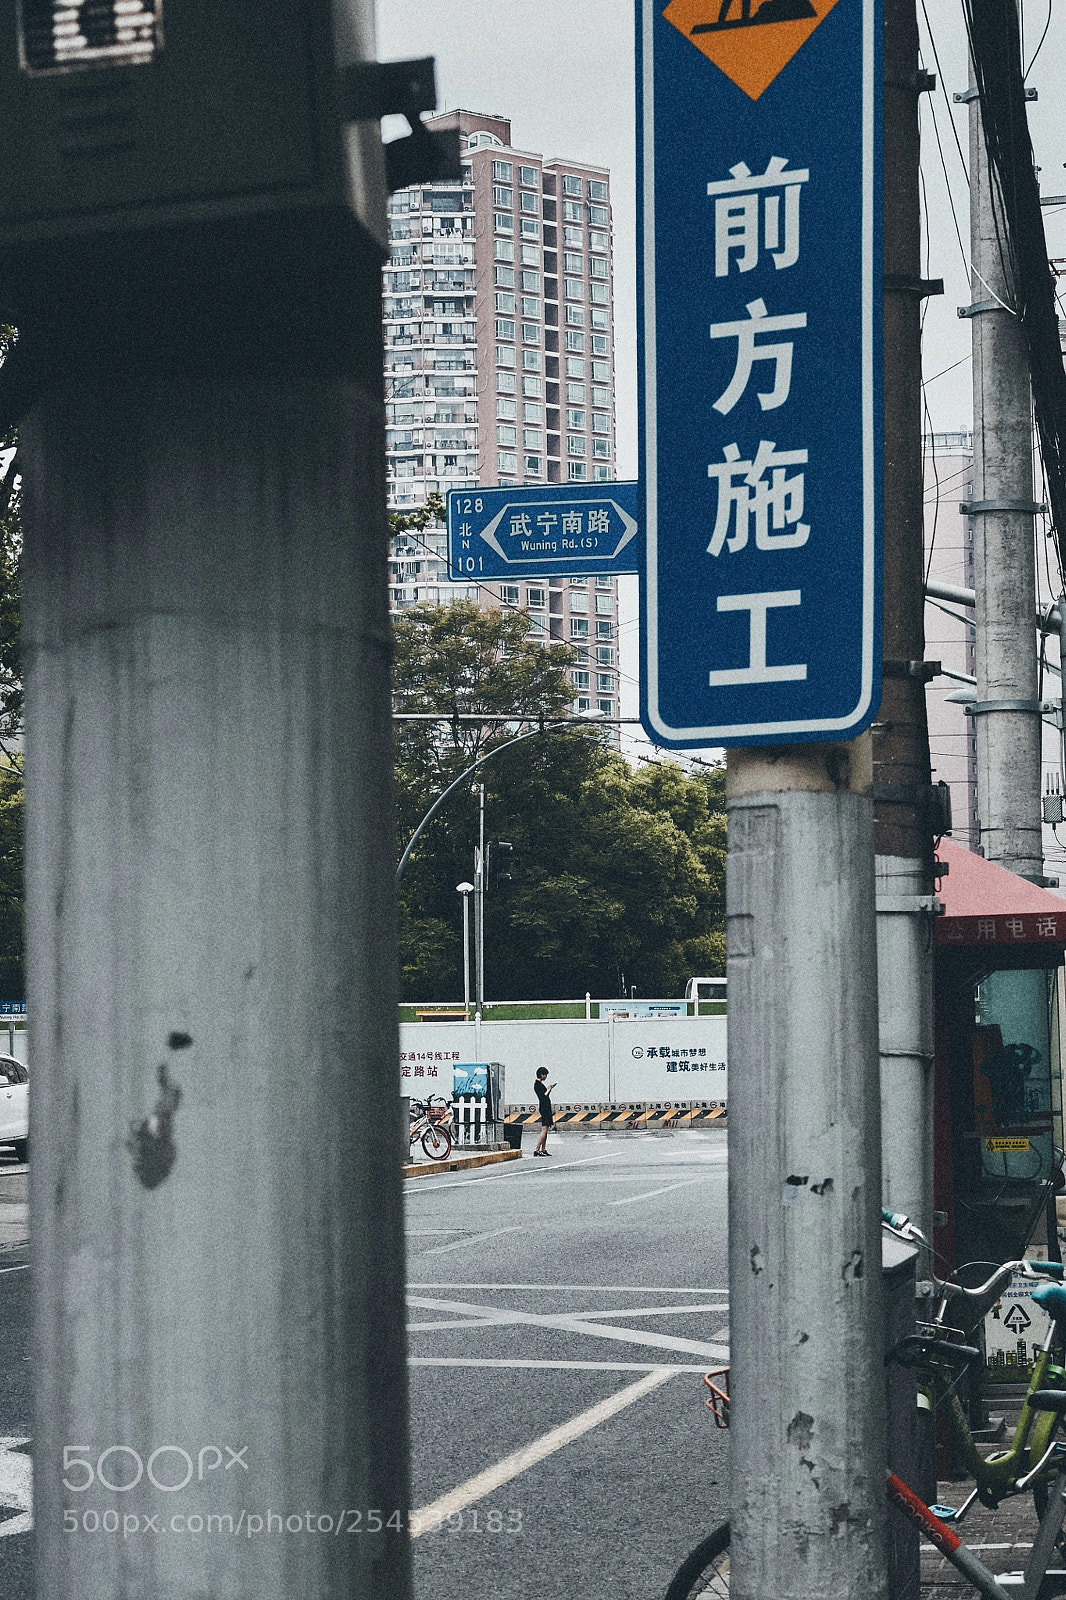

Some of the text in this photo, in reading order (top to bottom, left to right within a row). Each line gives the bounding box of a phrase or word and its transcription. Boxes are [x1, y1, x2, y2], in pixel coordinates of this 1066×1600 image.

[707, 155, 811, 686] 前方施工
[456, 498, 484, 514] 128
[459, 522, 472, 537] 北
[509, 509, 611, 537] 武宁南路
[462, 540, 470, 549] N
[521, 537, 599, 552] Wuning Rd.(S)
[458, 557, 484, 572] 101
[945, 917, 1058, 939] 公用电话
[647, 1046, 707, 1058] 承载城市梦想
[401, 1065, 438, 1077] 定路站
[666, 1061, 726, 1072] 建筑美好生活
